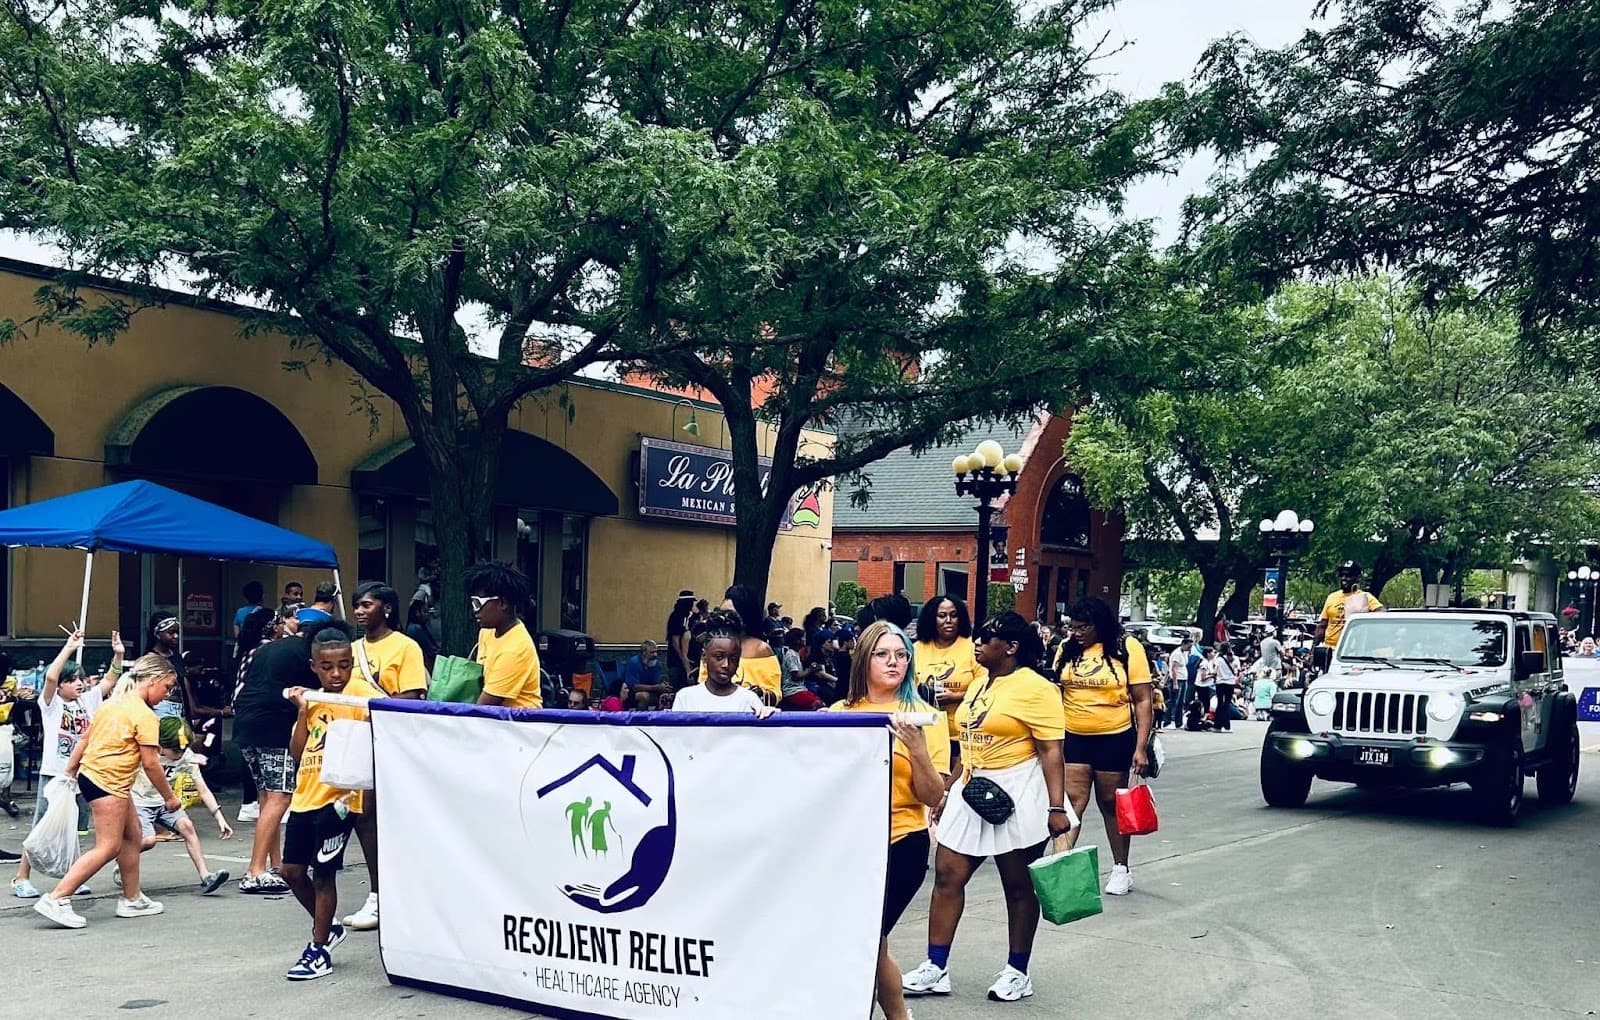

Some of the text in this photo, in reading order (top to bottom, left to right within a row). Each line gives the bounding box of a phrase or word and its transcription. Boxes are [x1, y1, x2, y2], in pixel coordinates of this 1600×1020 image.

[658, 455, 700, 490] La
[681, 496, 726, 511] MEXICAN
[1088, 678, 1109, 686] RELIEF
[973, 733, 994, 746] RELIEF
[1359, 751, 1374, 761] JTX
[504, 914, 714, 978] RESILIENT RELIEF
[535, 966, 681, 1009] HEALTHCARE AGENCY
